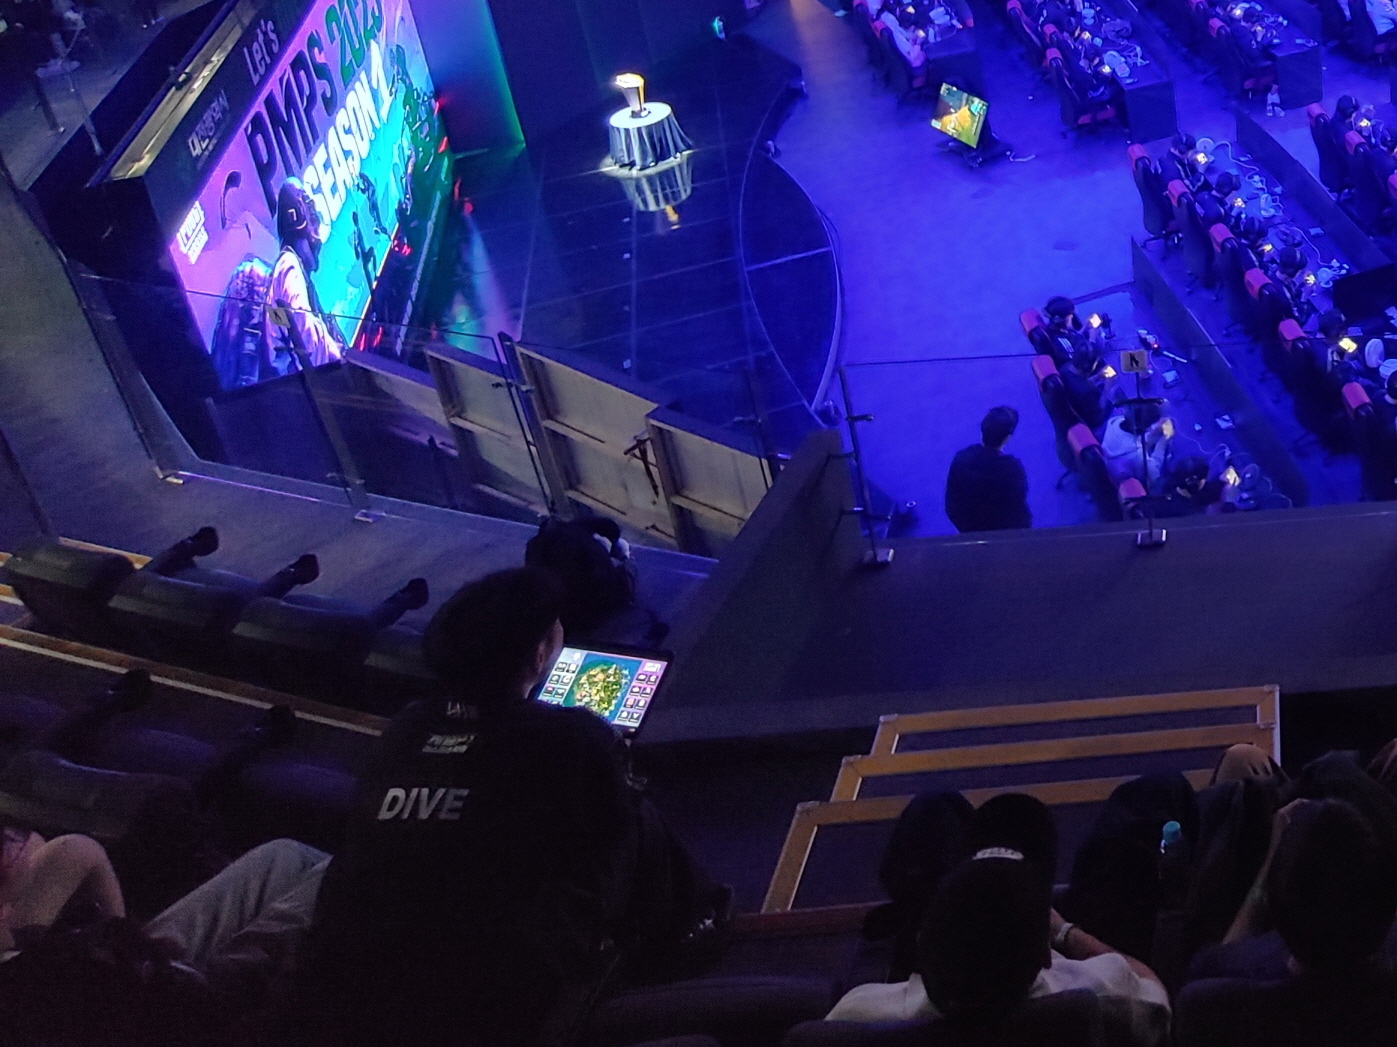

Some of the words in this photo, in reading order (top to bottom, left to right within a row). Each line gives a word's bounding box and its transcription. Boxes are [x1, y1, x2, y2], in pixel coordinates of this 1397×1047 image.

[243, 18, 281, 87] Let's
[245, 29, 338, 220] PMPS
[303, 70, 382, 245] SEASON
[370, 38, 395, 125] 1
[377, 787, 470, 821] DIVE
